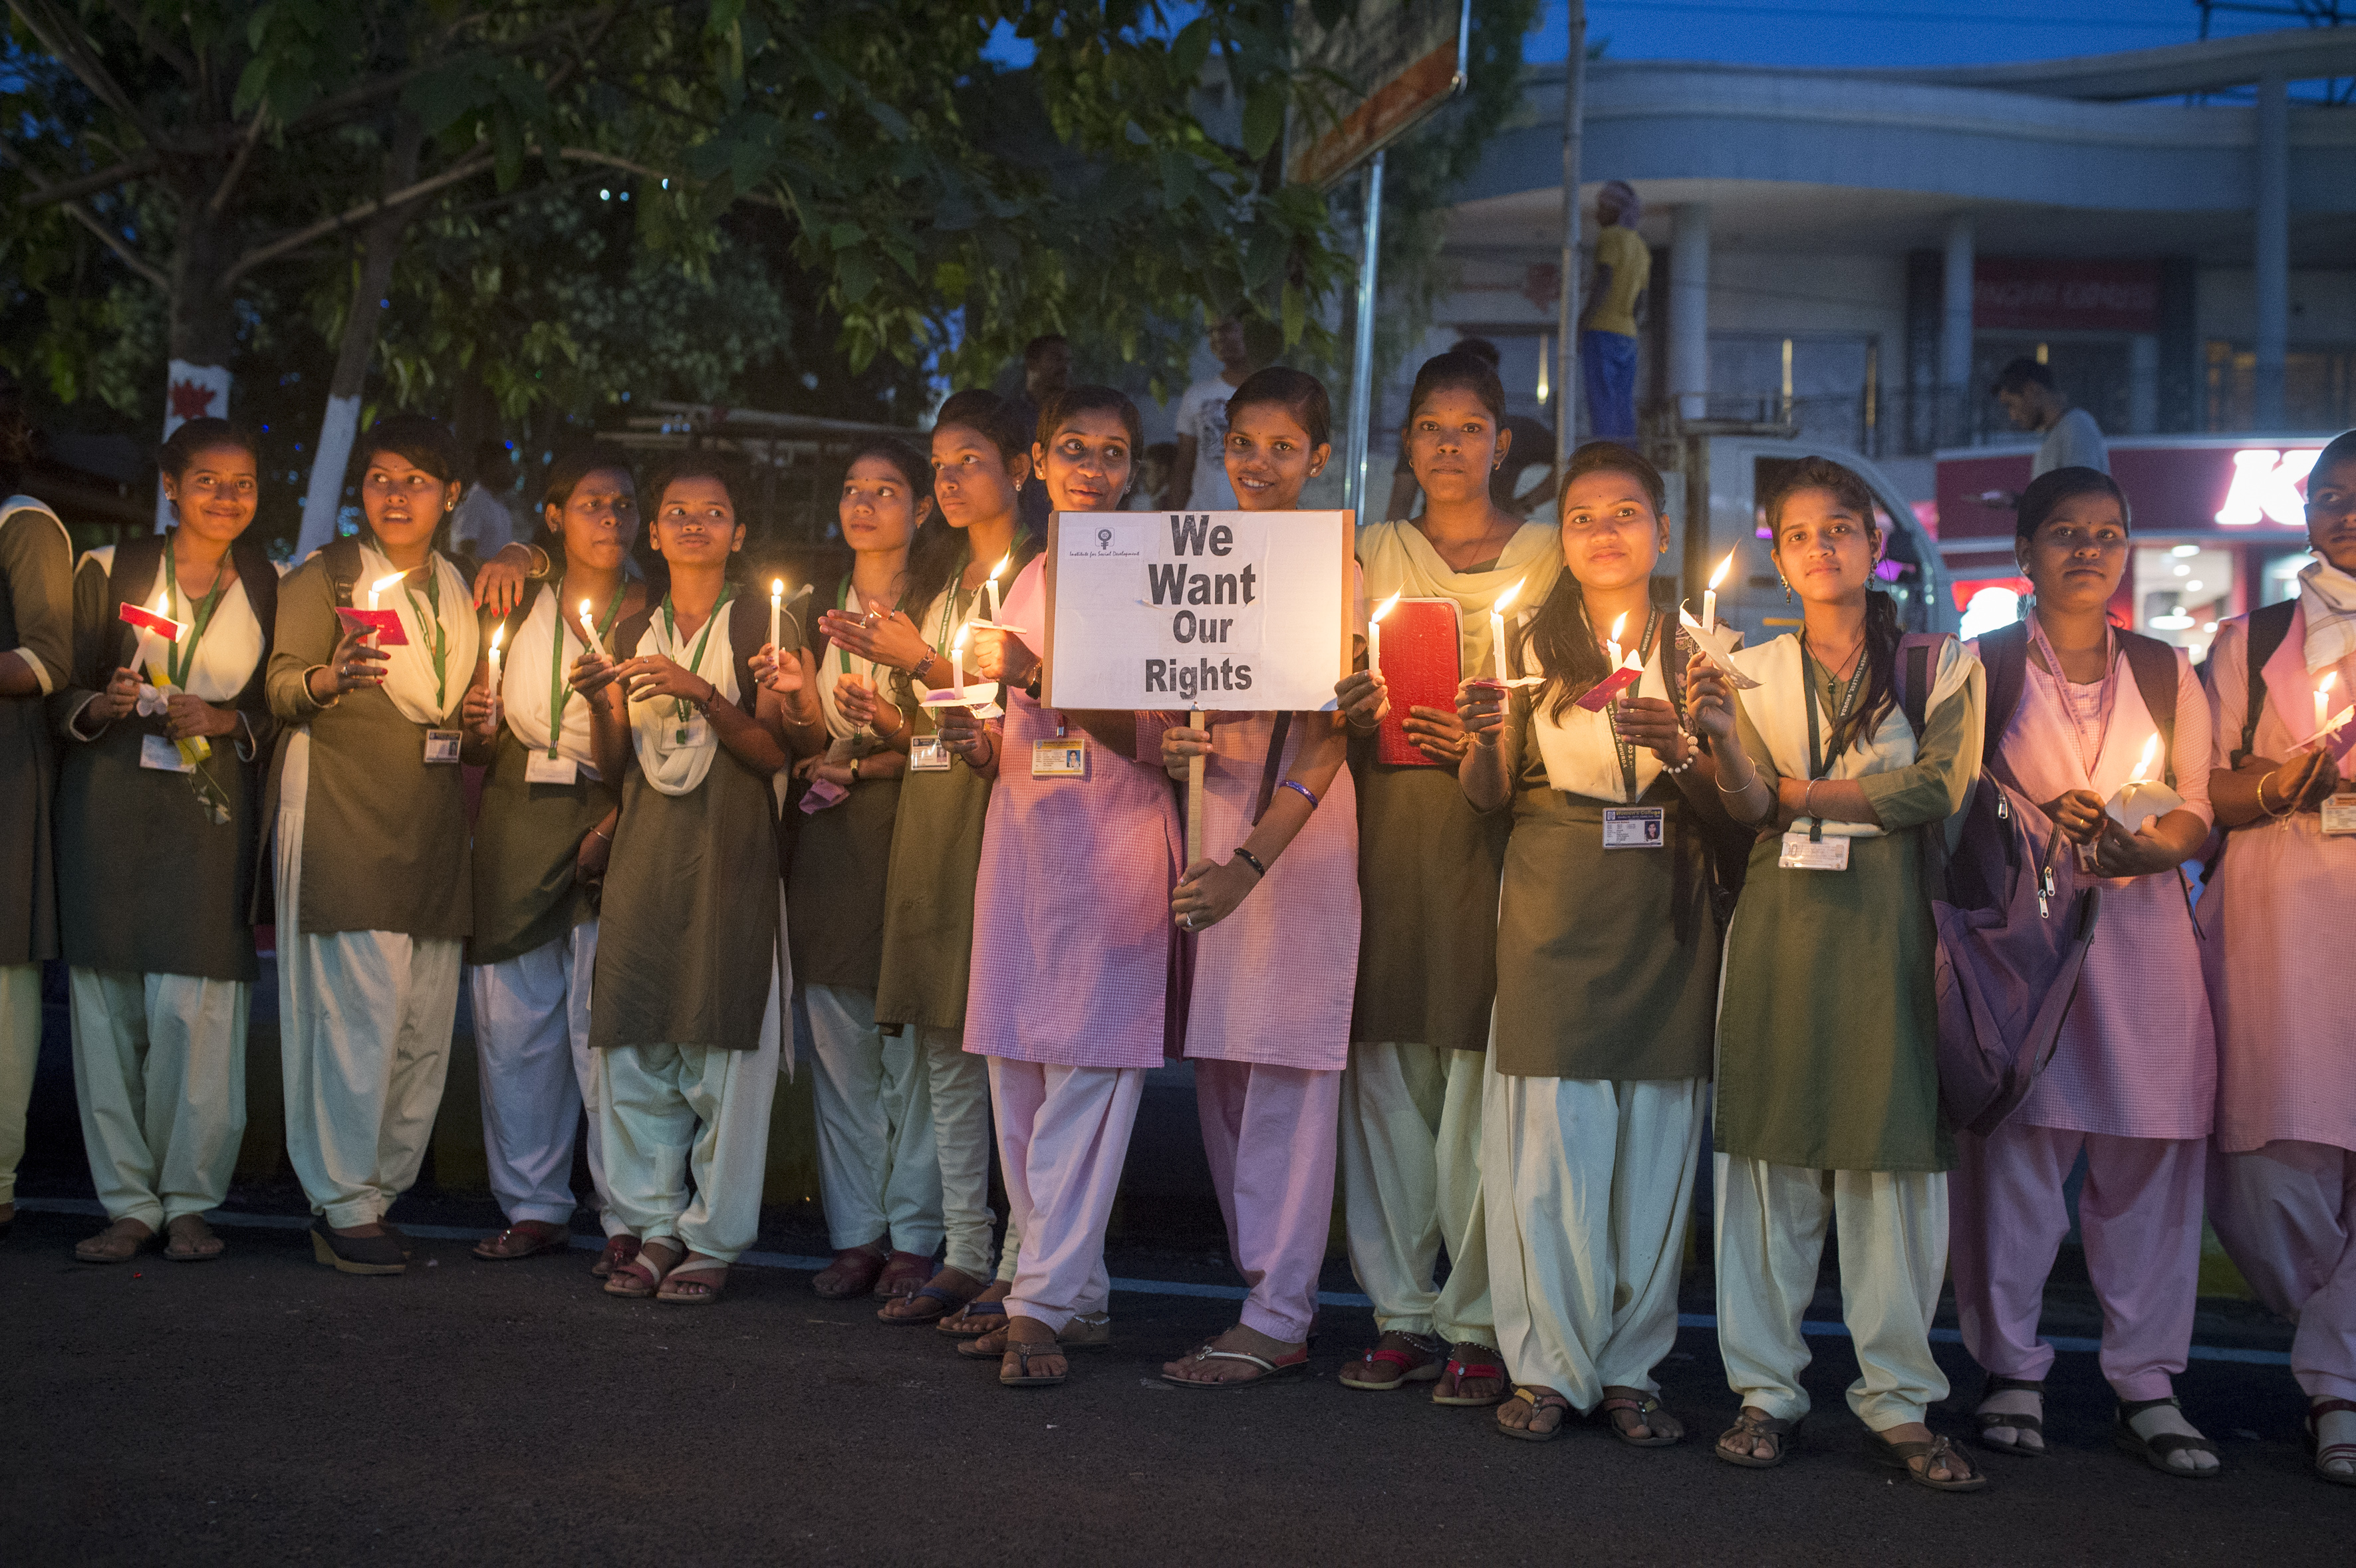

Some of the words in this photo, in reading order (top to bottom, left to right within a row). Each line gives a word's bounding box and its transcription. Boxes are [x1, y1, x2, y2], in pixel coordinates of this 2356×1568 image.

[1170, 515, 1234, 557] We
[1148, 563, 1256, 605] Want
[1173, 610, 1234, 644] Our
[1642, 630, 1651, 652] WOMEN'S
[1145, 658, 1253, 700] Rights
[1840, 694, 1853, 717] KHURDA
[1617, 743, 1628, 769] KHURDA
